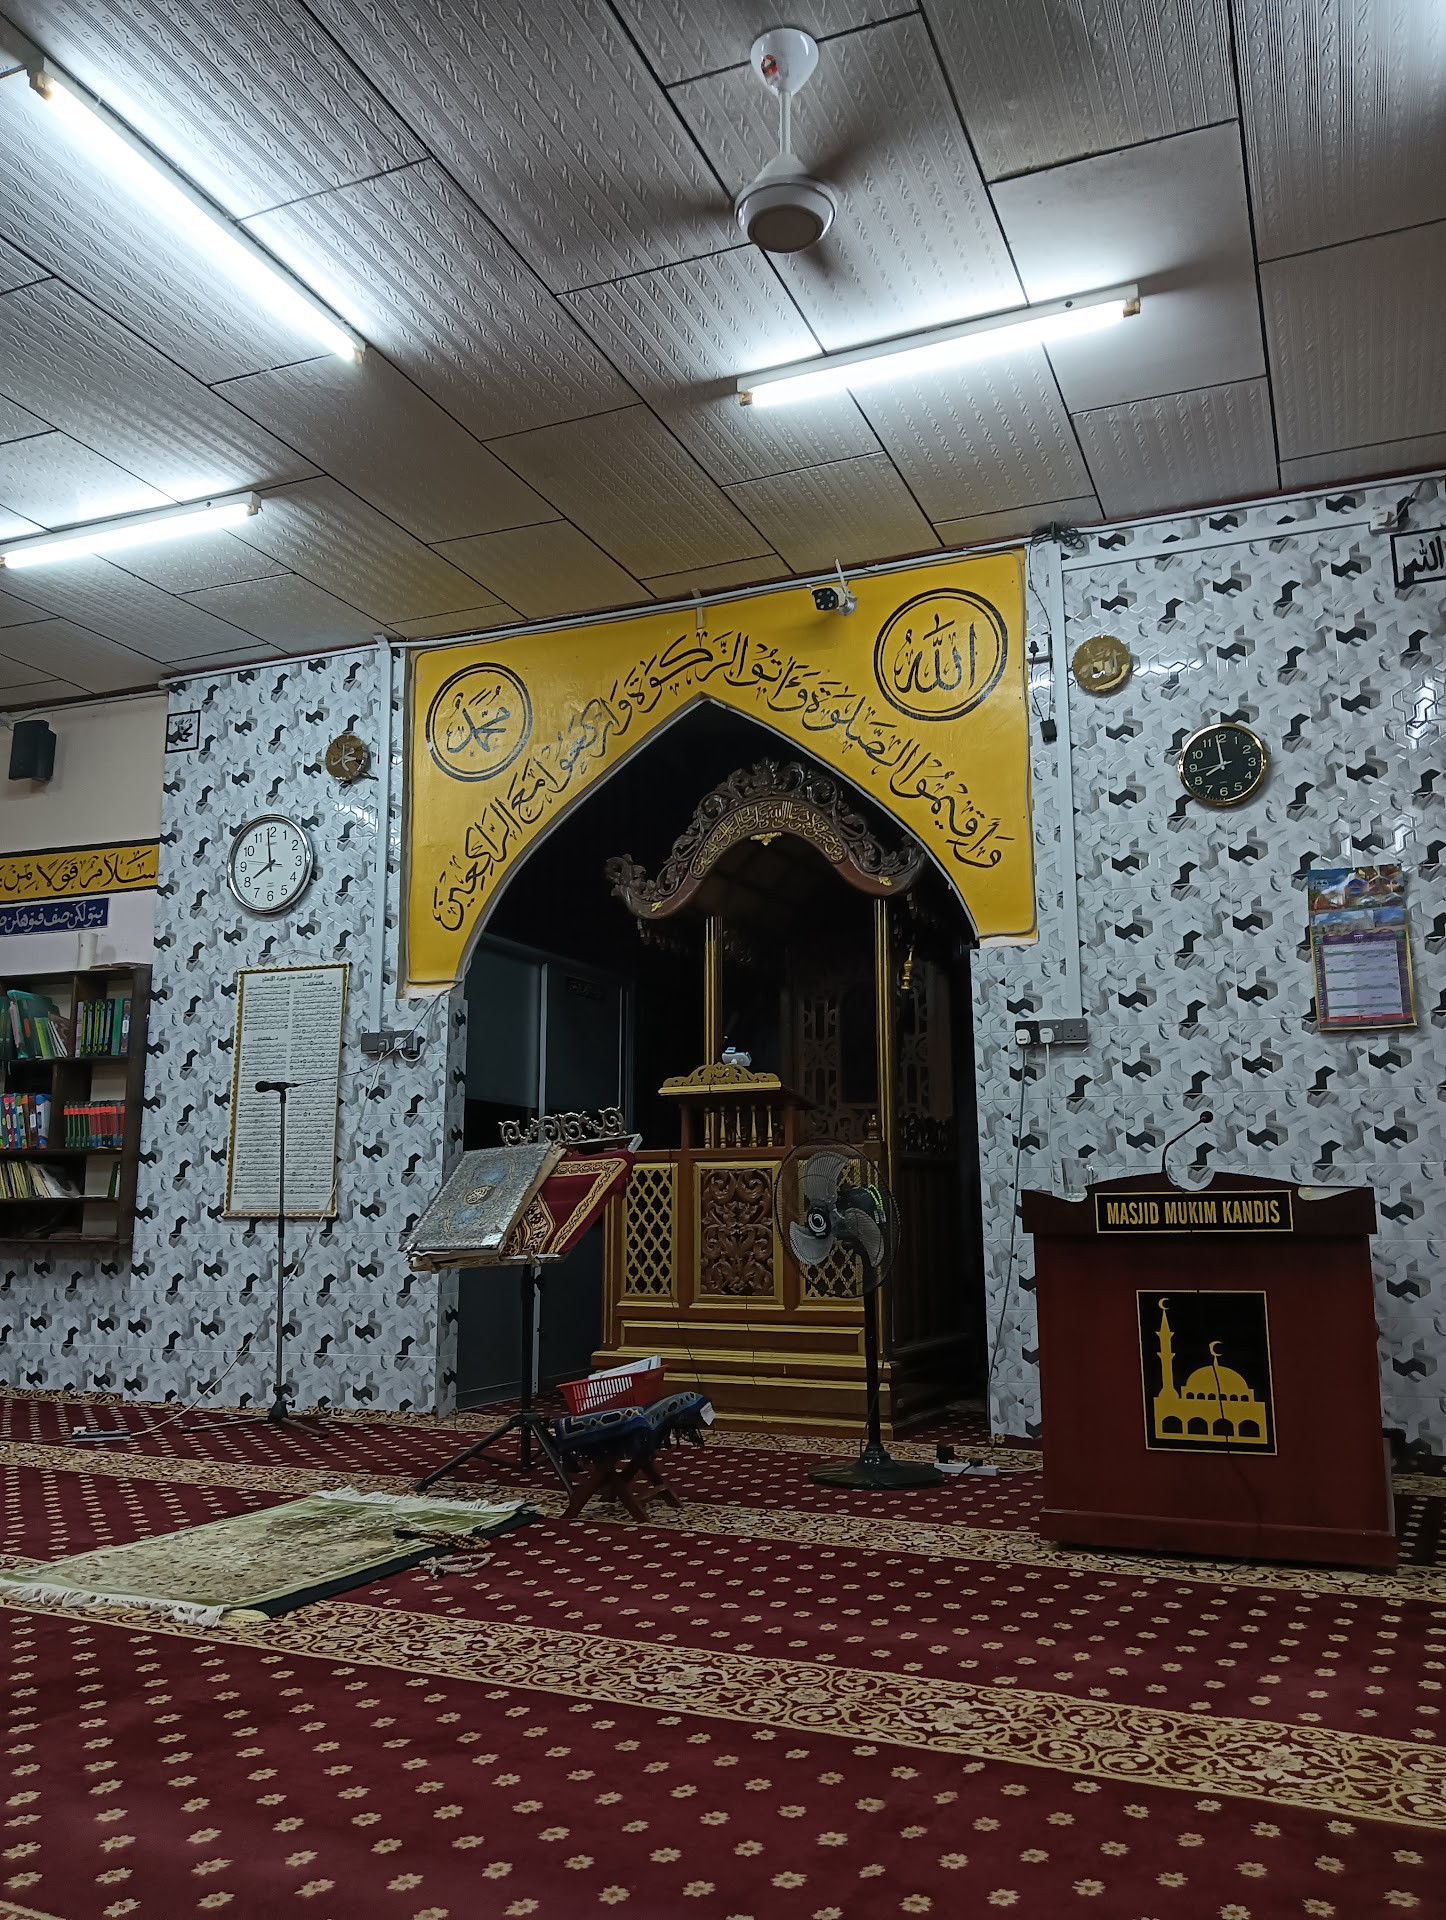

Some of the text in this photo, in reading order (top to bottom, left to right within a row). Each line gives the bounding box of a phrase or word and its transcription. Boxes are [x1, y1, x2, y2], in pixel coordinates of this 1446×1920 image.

[893, 613, 977, 693] الله
[446, 685, 511, 756] محمد
[1202, 738, 1212, 748] 11
[1235, 736, 1238, 745] 1
[1192, 750, 1203, 759] 10
[1242, 745, 1251, 754] 2
[1189, 763, 1198, 772] 9
[1247, 757, 1256, 767] 3
[1194, 776, 1203, 785] 8
[1244, 771, 1252, 780] 4
[1205, 784, 1213, 794] 7
[1219, 787, 1229, 796] 6
[1234, 782, 1243, 791] 5
[254, 832, 263, 844] 11
[282, 830, 287, 840] 1
[291, 839, 299, 851] 2
[243, 845, 255, 857] 10
[240, 861, 247, 872] 9
[294, 855, 302, 867] 3
[243, 876, 251, 888] 8
[289, 871, 297, 882] 4
[253, 887, 260, 898] 7
[266, 890, 274, 901] 6
[280, 884, 288, 896] 5
[1107, 1199, 1281, 1225] MASJID MUKIM KANDIS
